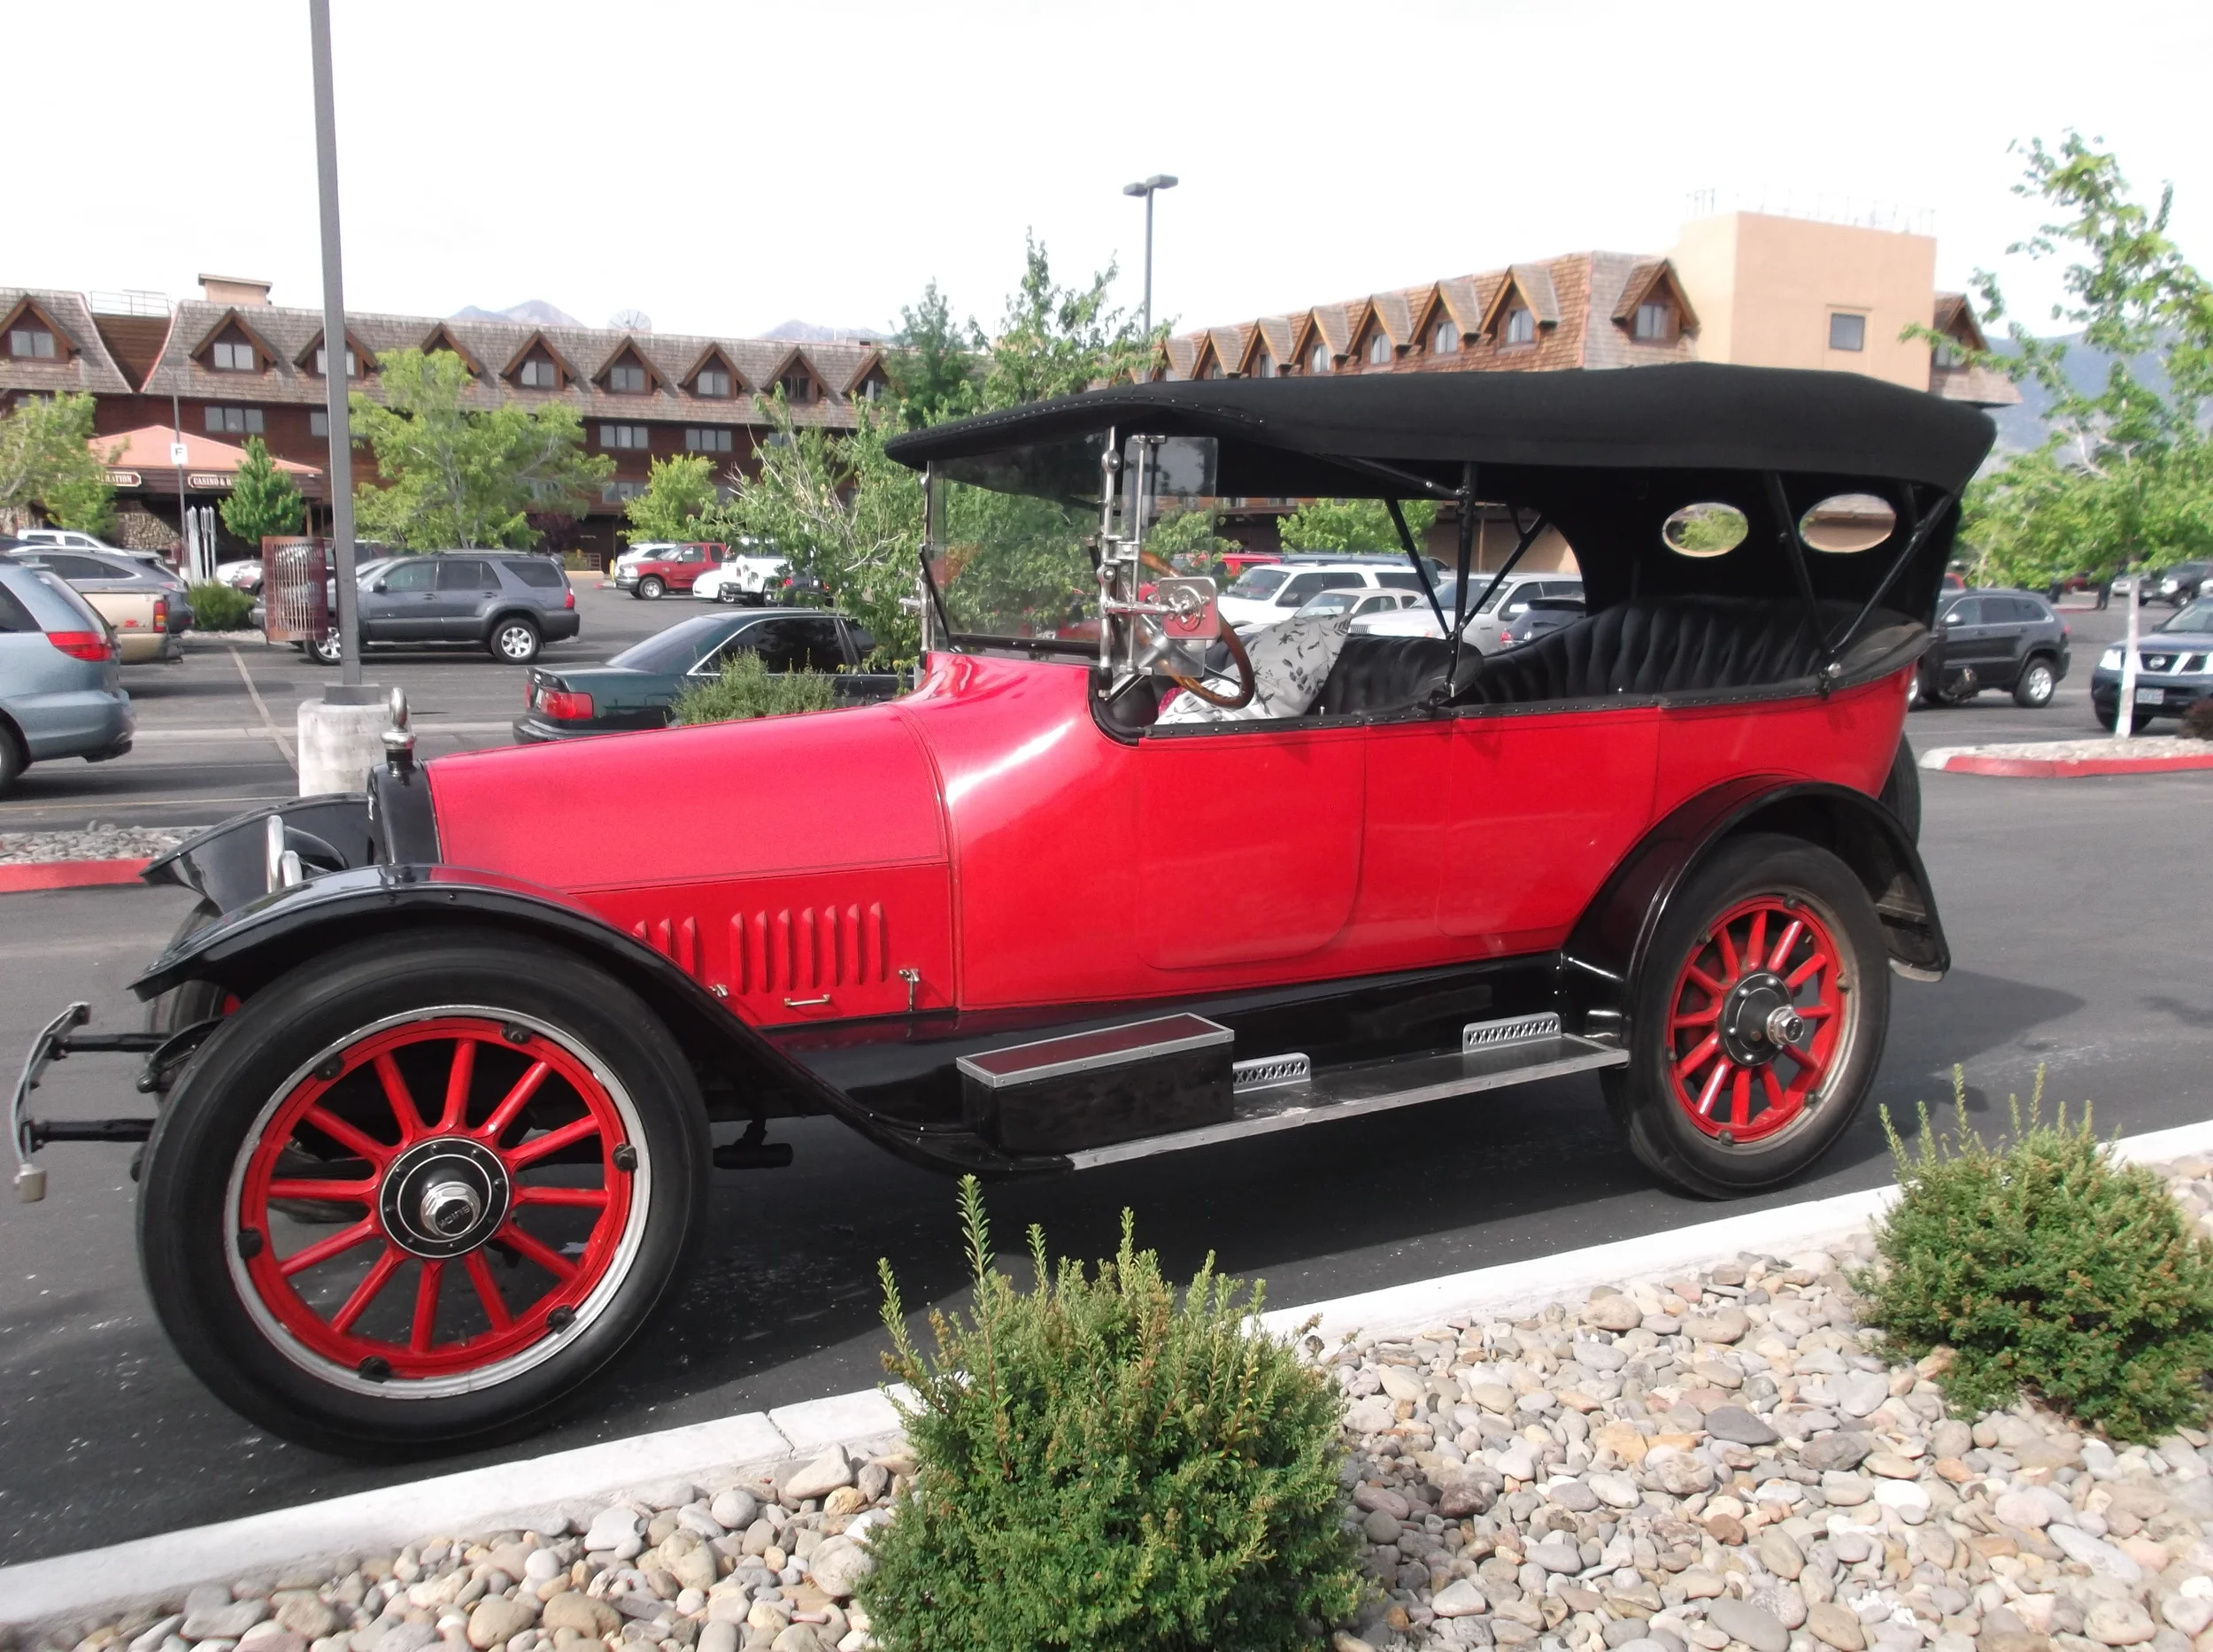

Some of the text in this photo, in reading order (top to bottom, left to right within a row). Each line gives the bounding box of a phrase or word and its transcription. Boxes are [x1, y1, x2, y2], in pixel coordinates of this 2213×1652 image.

[174, 447, 184, 456] F
[193, 477, 219, 486] CASINO
[440, 1207, 471, 1229] BUICK
